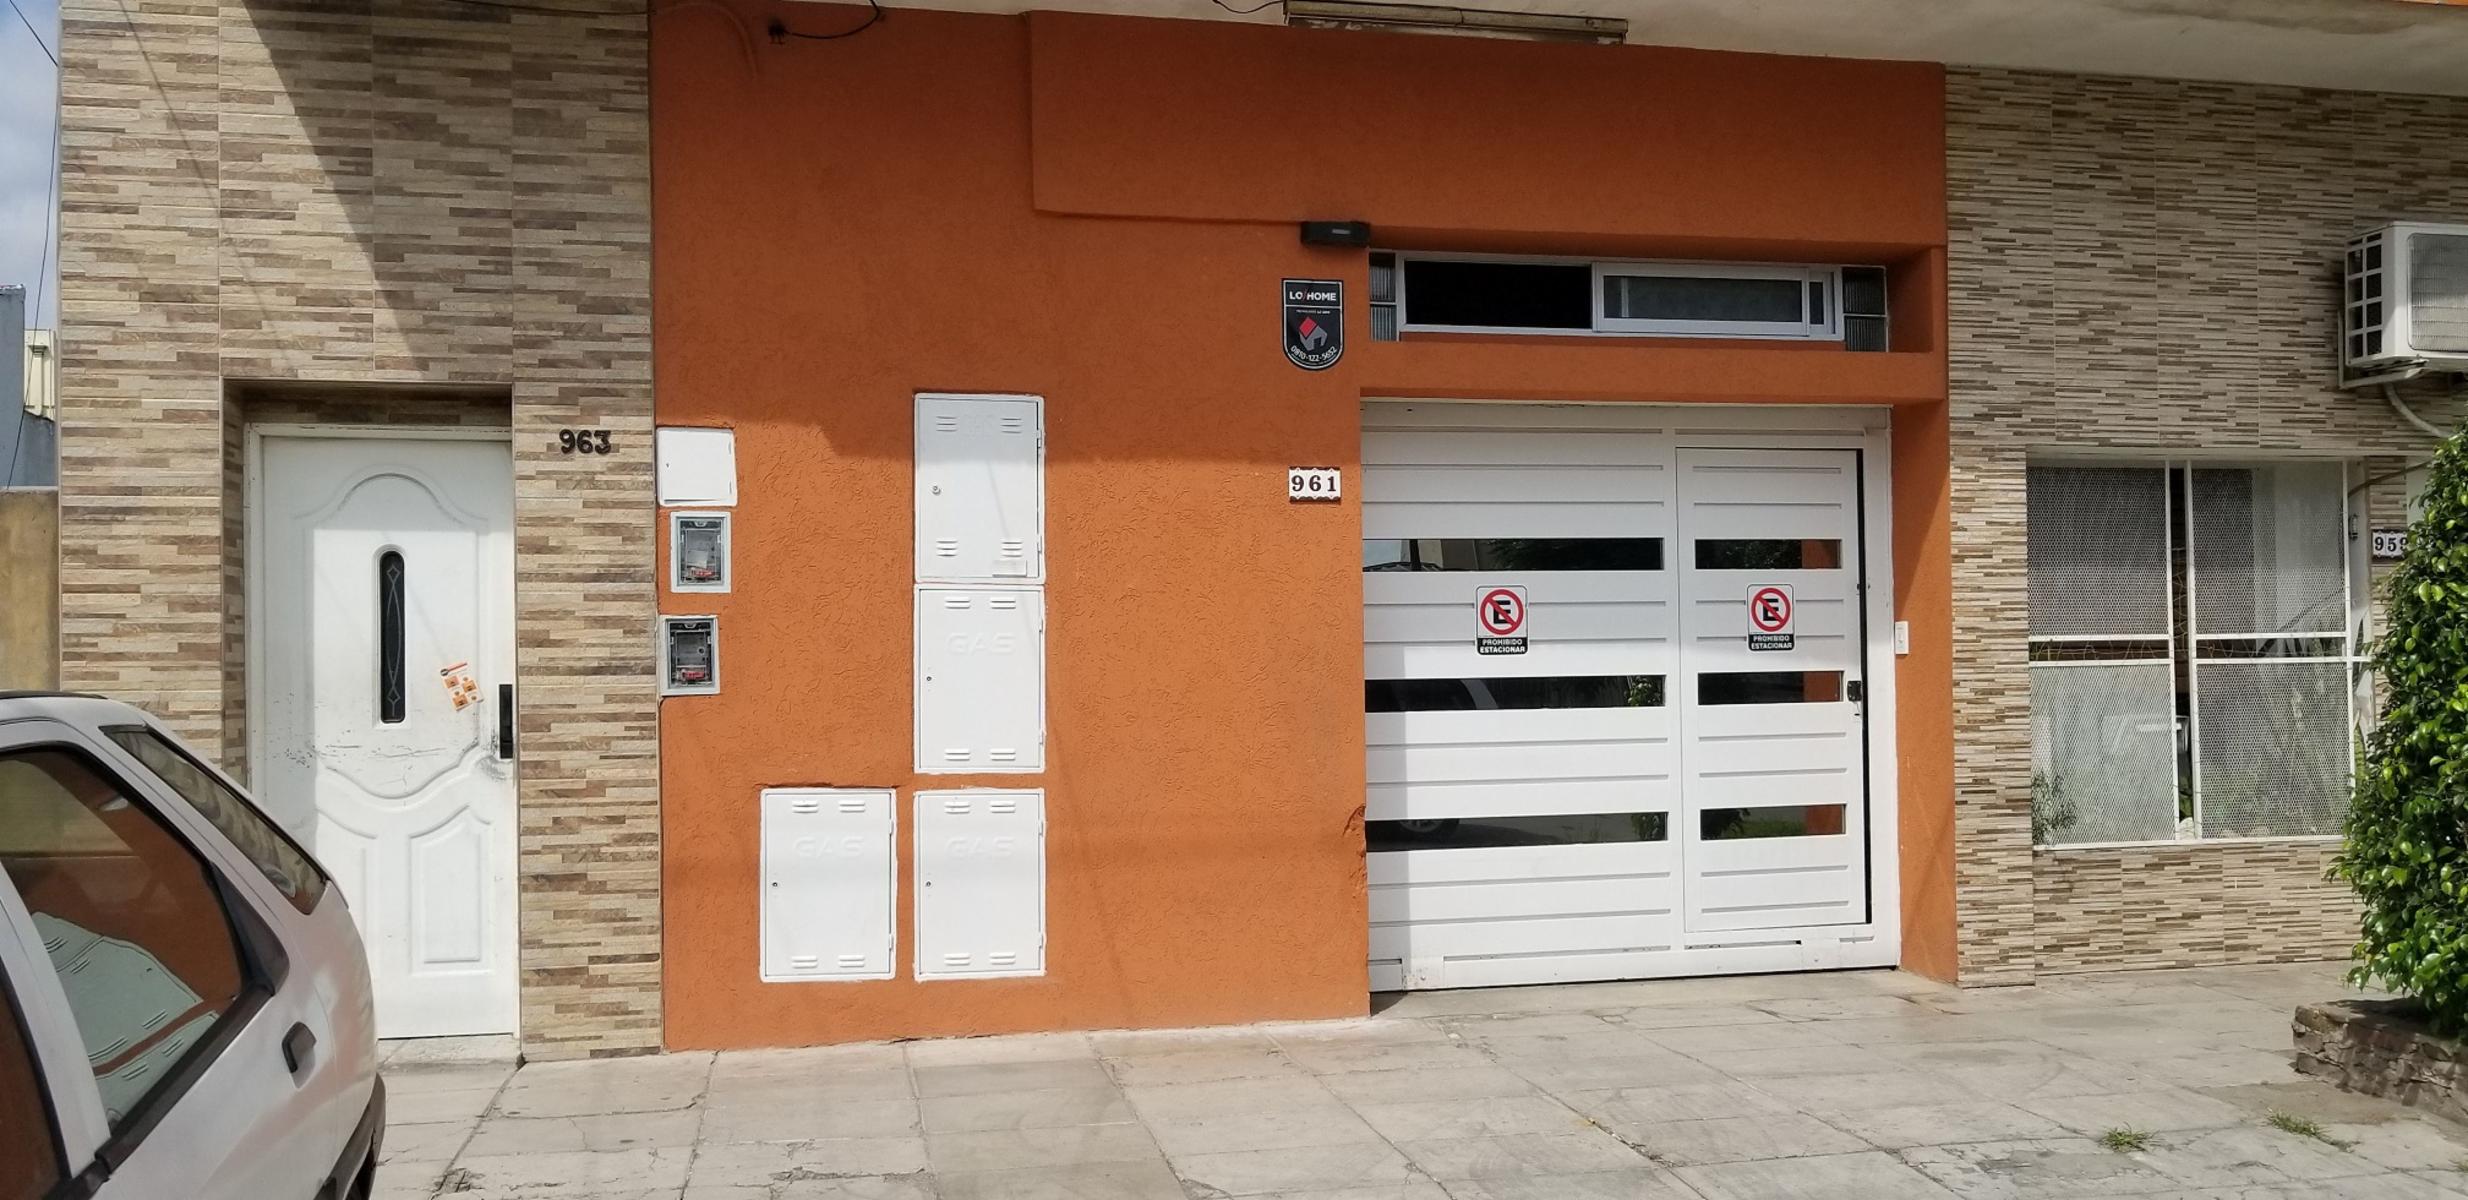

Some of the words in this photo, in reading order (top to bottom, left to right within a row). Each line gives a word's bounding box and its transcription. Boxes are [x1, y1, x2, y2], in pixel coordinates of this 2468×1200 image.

[559, 429, 611, 455] 963
[1291, 474, 1337, 492] 961
[2374, 536, 2409, 552] 959
[945, 631, 1017, 655] GAS
[1480, 646, 1526, 654] ESTACIONAR
[1482, 638, 1523, 646] PROHIBIDO
[1751, 642, 1793, 650] ESTACIONAR
[792, 835, 866, 858] GAS
[944, 835, 1017, 859] GAS
